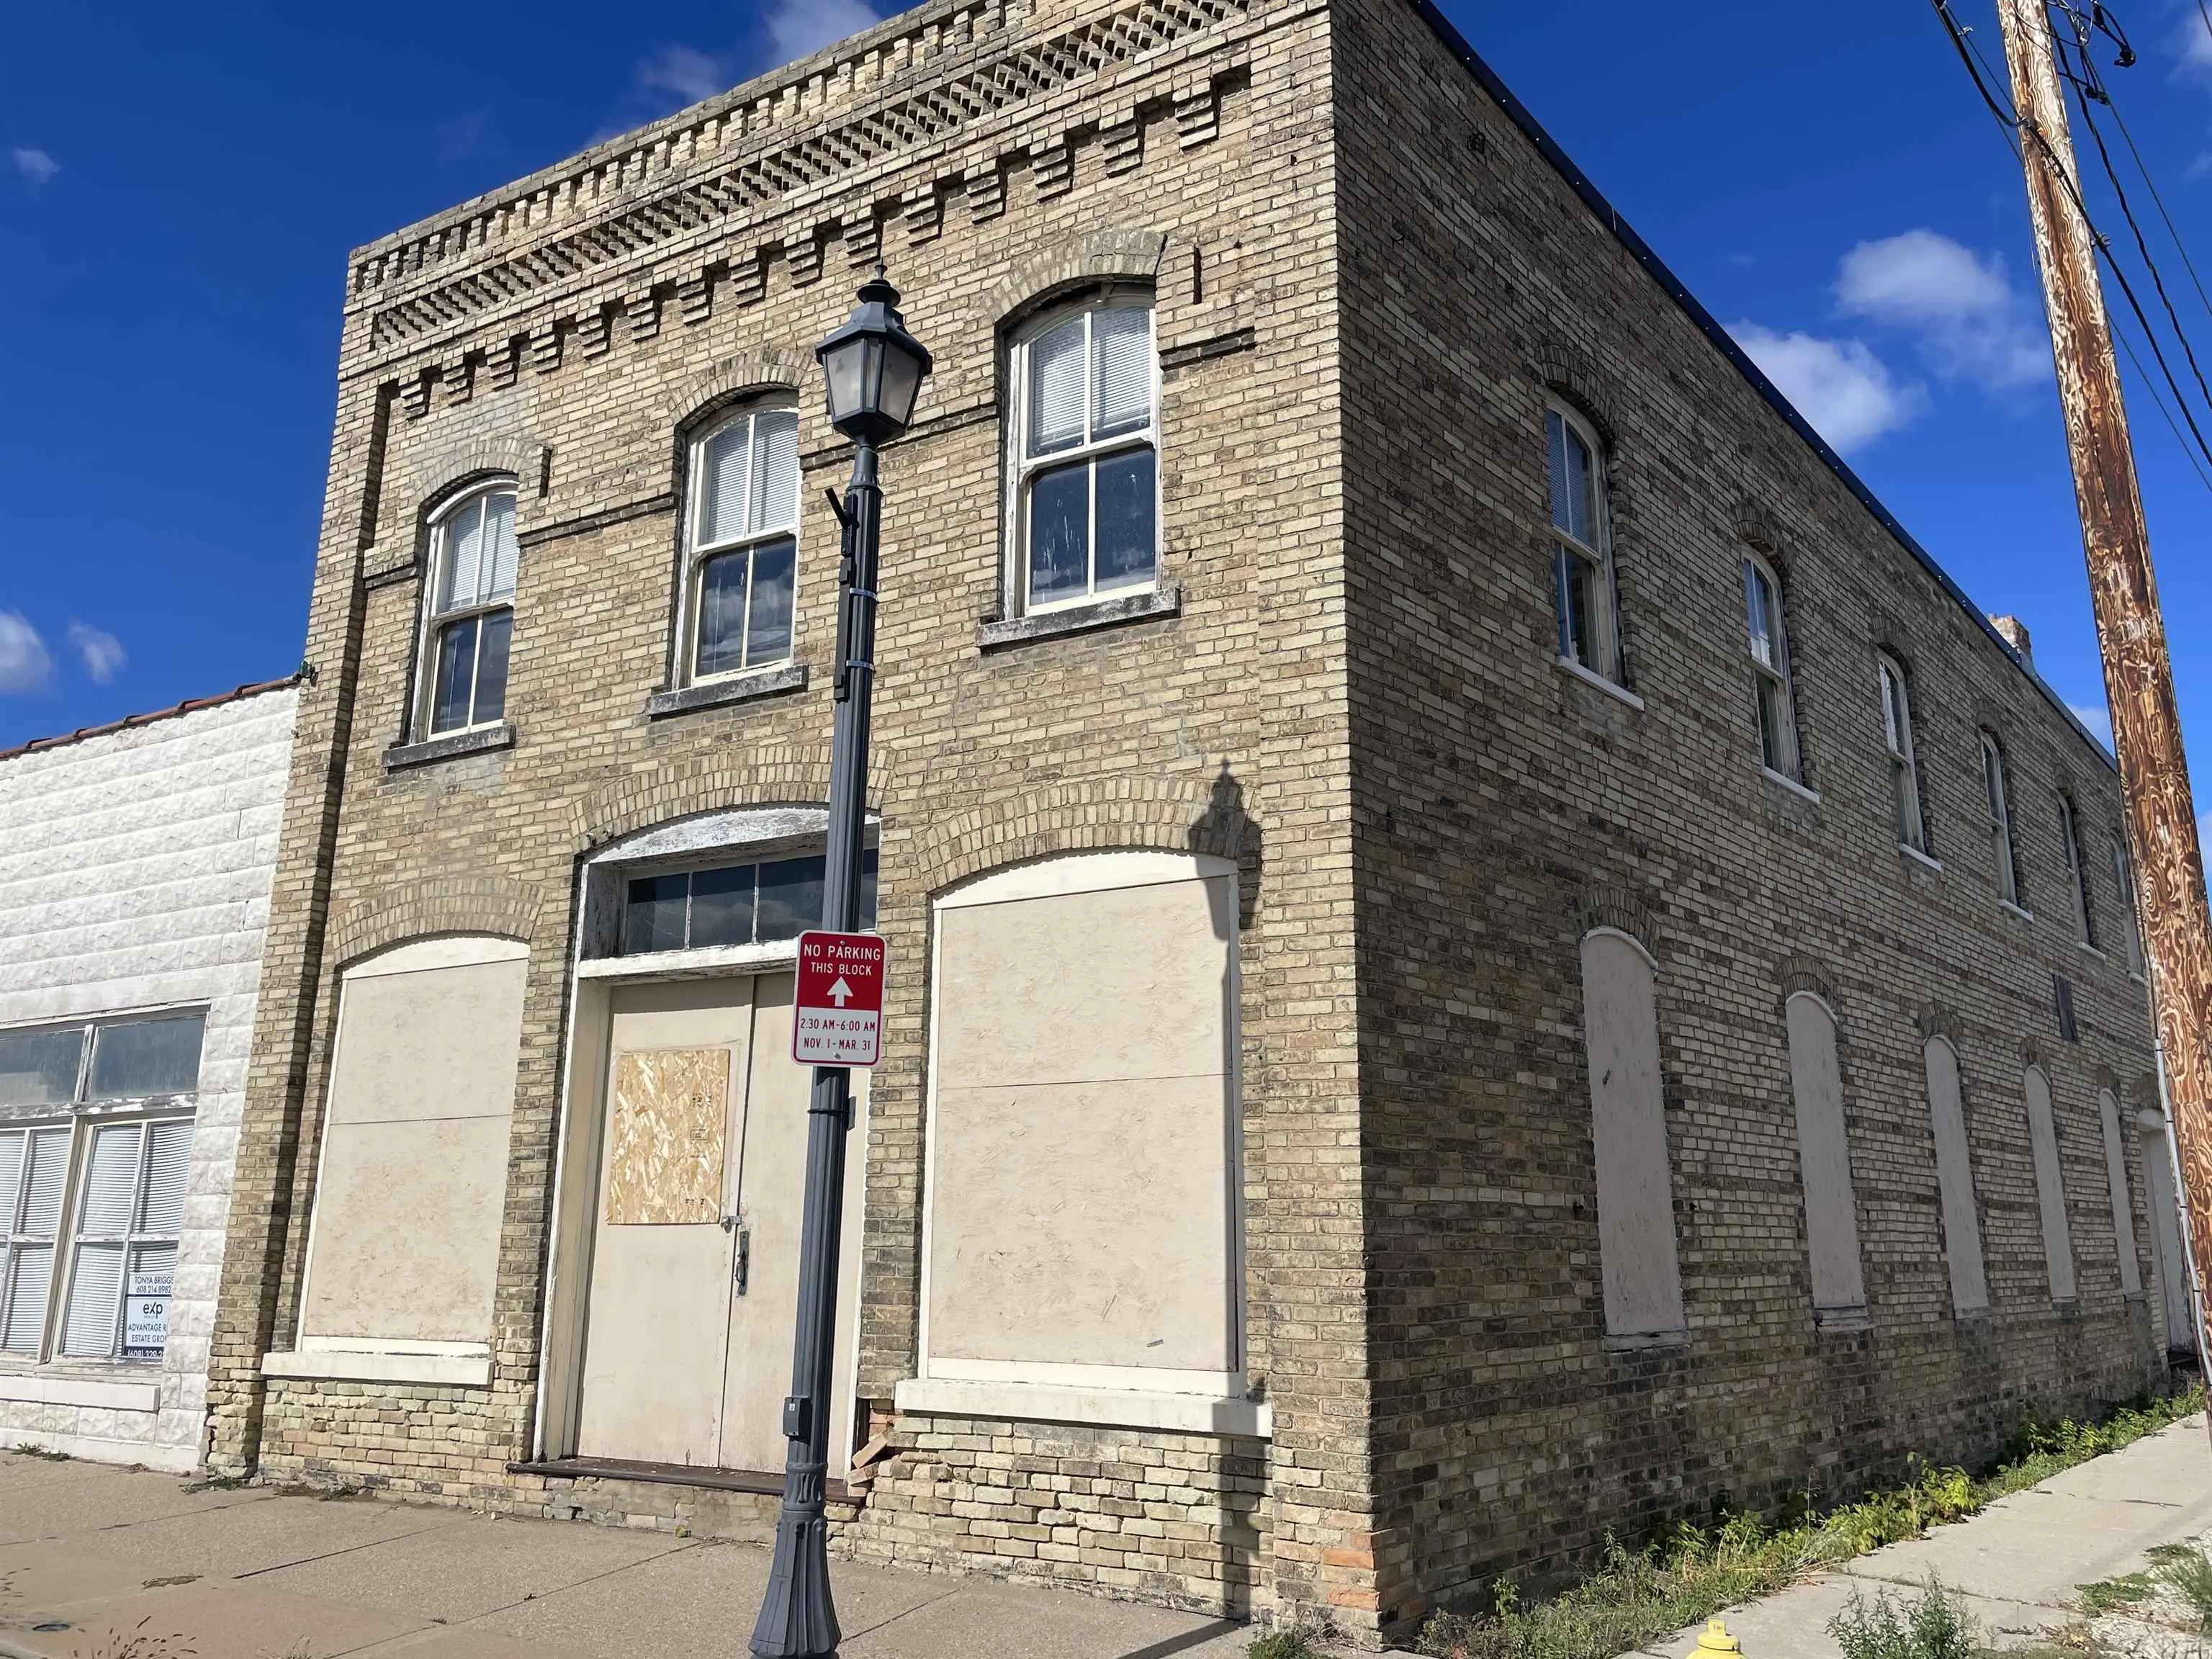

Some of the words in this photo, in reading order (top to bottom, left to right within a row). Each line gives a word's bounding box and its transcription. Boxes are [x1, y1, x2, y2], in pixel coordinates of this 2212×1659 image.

[804, 944, 821, 957] NO
[828, 945, 881, 961] PARKING
[811, 962, 833, 974] THIS
[839, 964, 872, 976] BLOCK
[801, 1018, 819, 1030] 2:30
[864, 1021, 876, 1032] AM
[804, 1037, 823, 1049] NOV.
[839, 1039, 858, 1051] MAR.
[862, 1040, 871, 1051] 31
[135, 1276, 154, 1285] TONYA
[154, 1276, 174, 1285] BRIGGS
[132, 1334, 150, 1343] ESTATE
